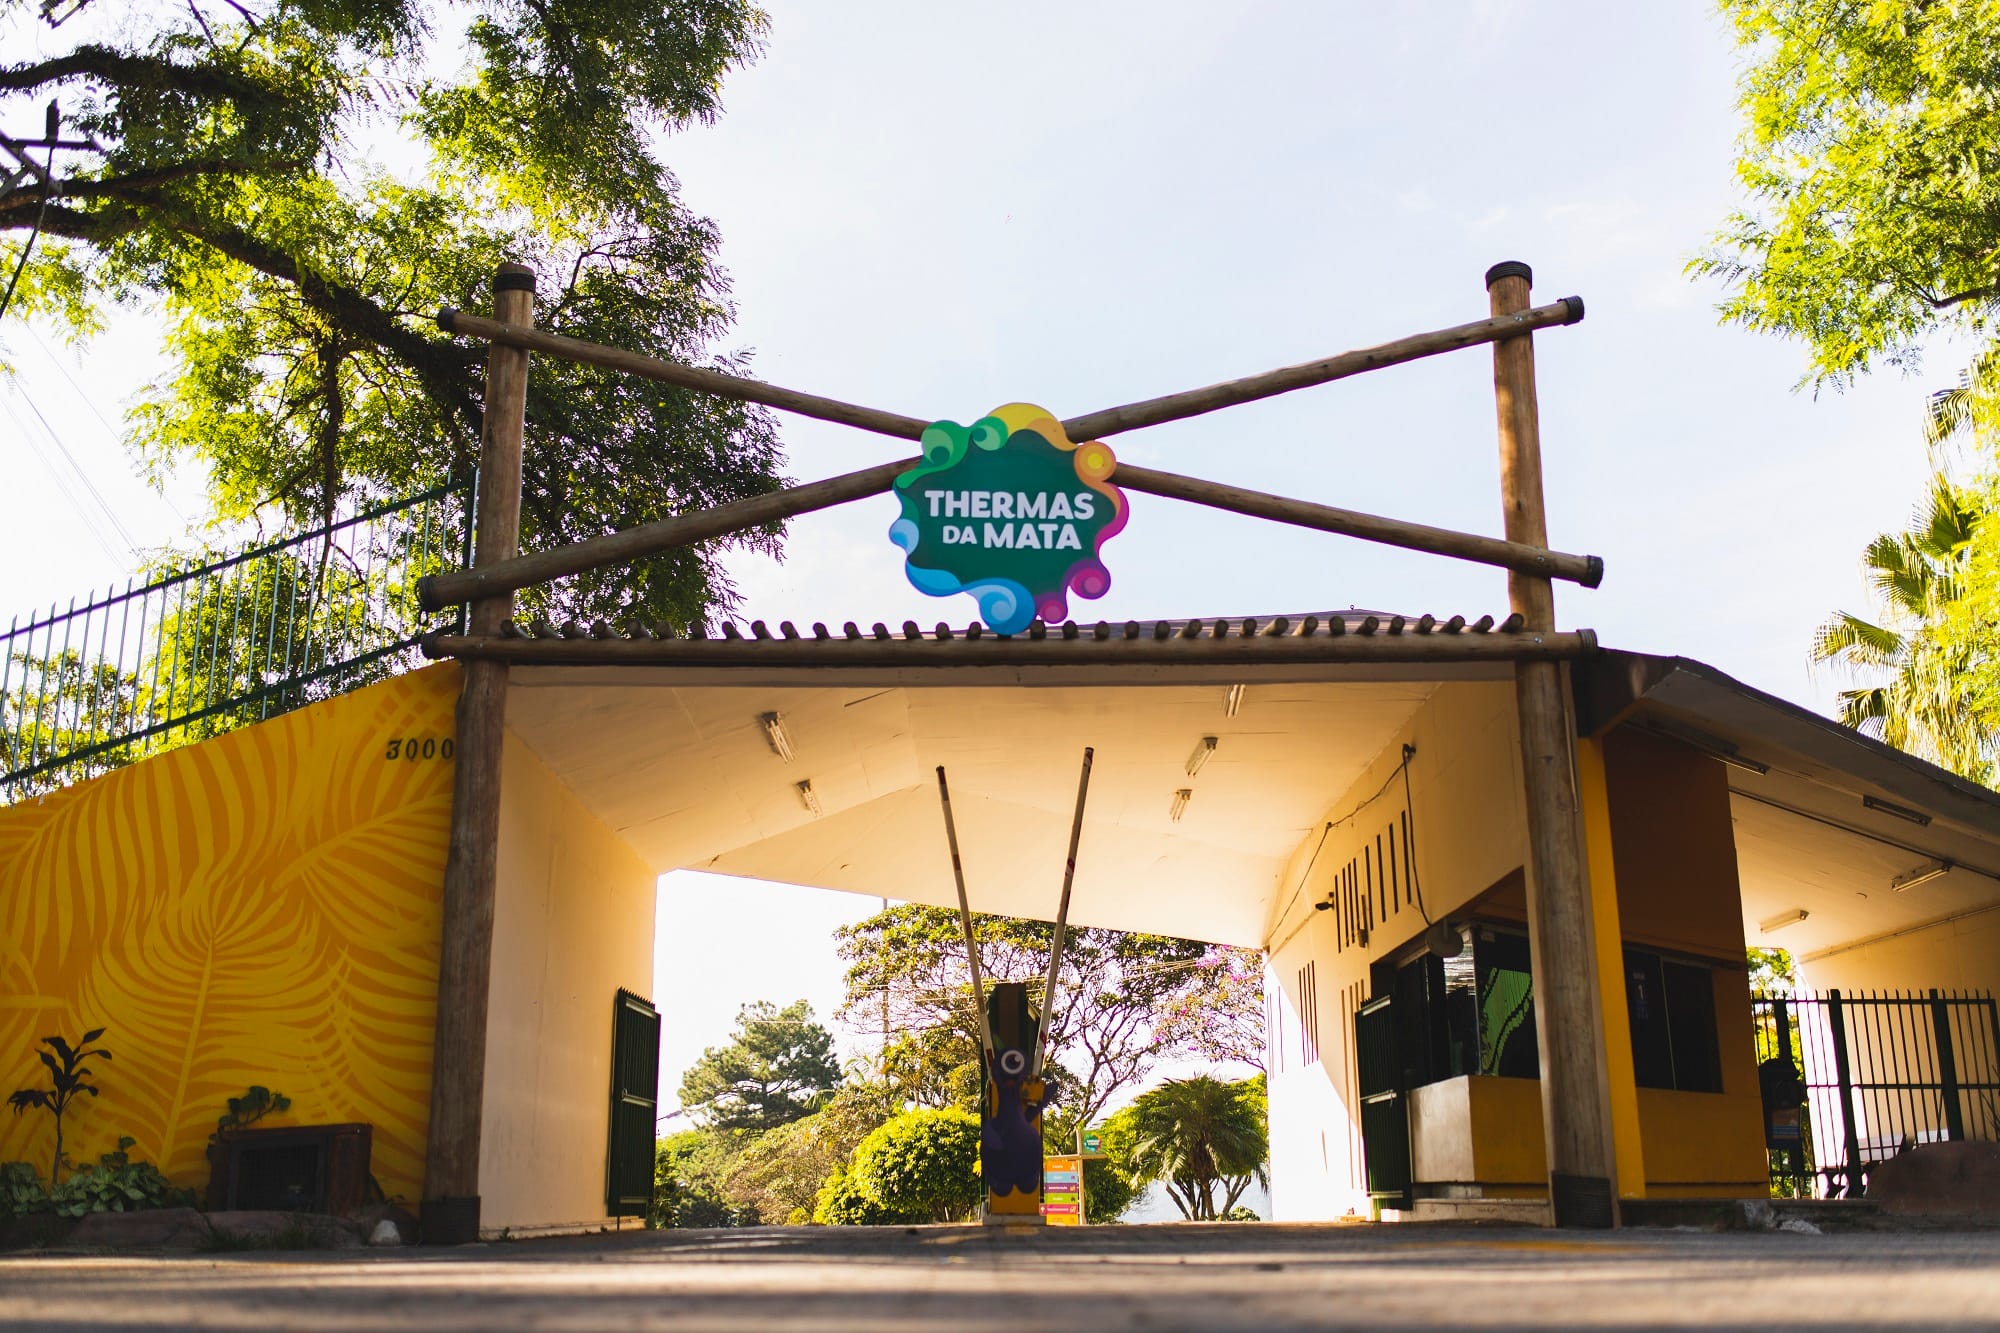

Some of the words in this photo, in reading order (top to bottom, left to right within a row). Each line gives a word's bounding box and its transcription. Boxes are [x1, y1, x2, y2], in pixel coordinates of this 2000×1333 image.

[924, 490, 1095, 520] THERMAS
[942, 525, 977, 545] DA
[983, 522, 1082, 550] MATA
[385, 738, 454, 760] 3000
